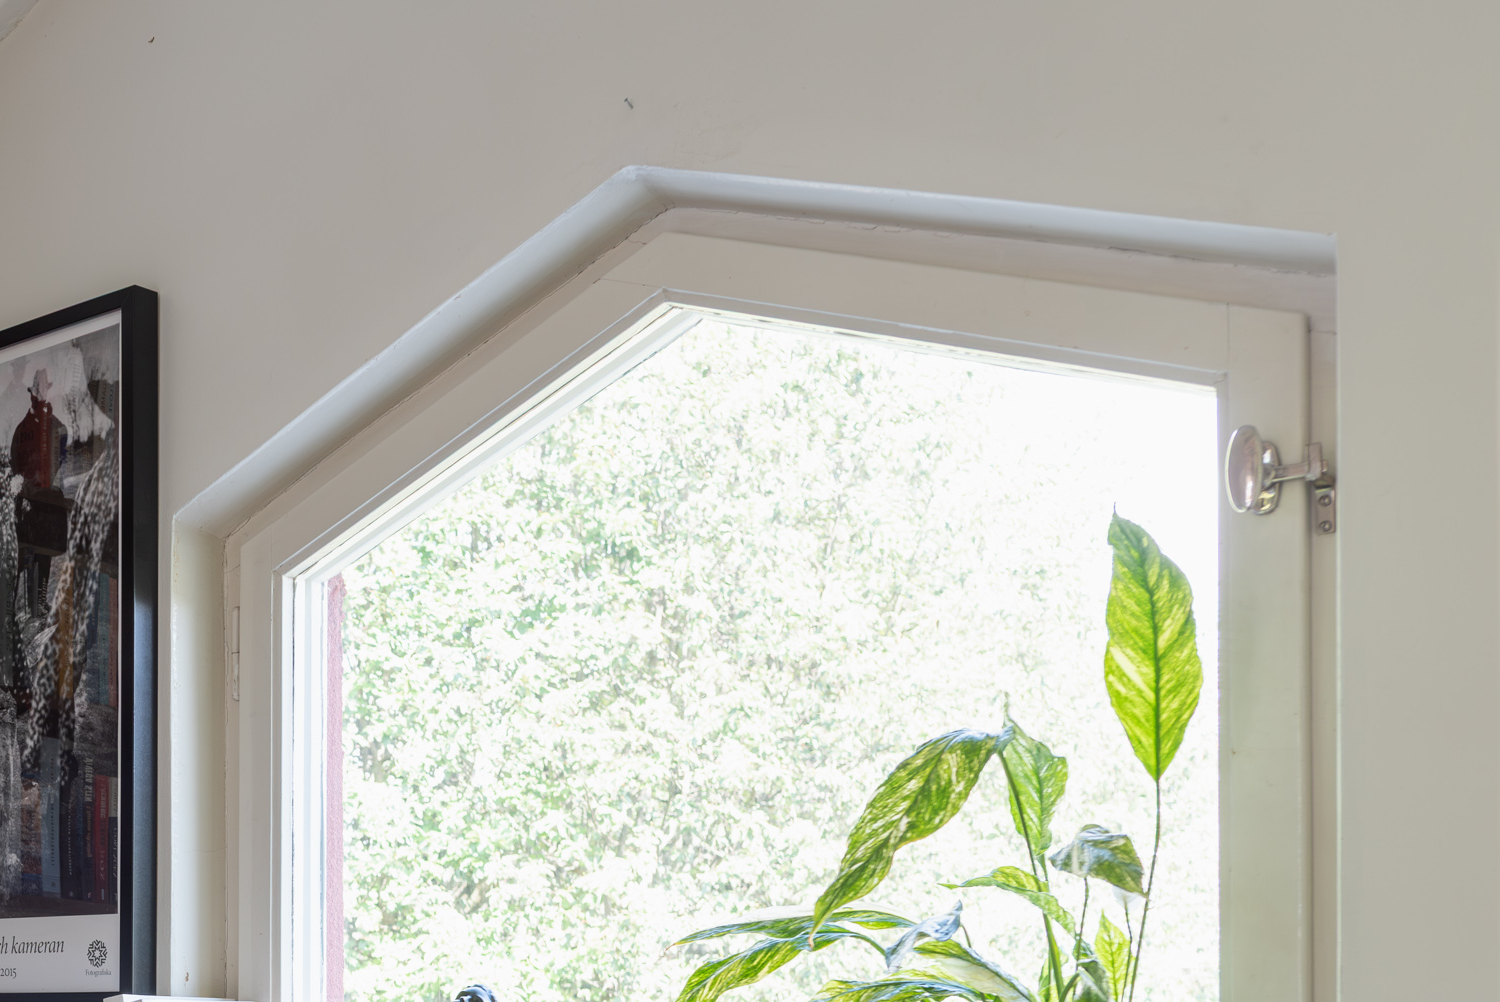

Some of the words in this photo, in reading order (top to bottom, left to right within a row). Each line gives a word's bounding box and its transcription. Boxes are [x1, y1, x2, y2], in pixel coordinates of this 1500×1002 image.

[11, 936, 64, 954] kameran
[0, 968, 17, 979] 2015
[86, 969, 112, 978] Fotografiska
